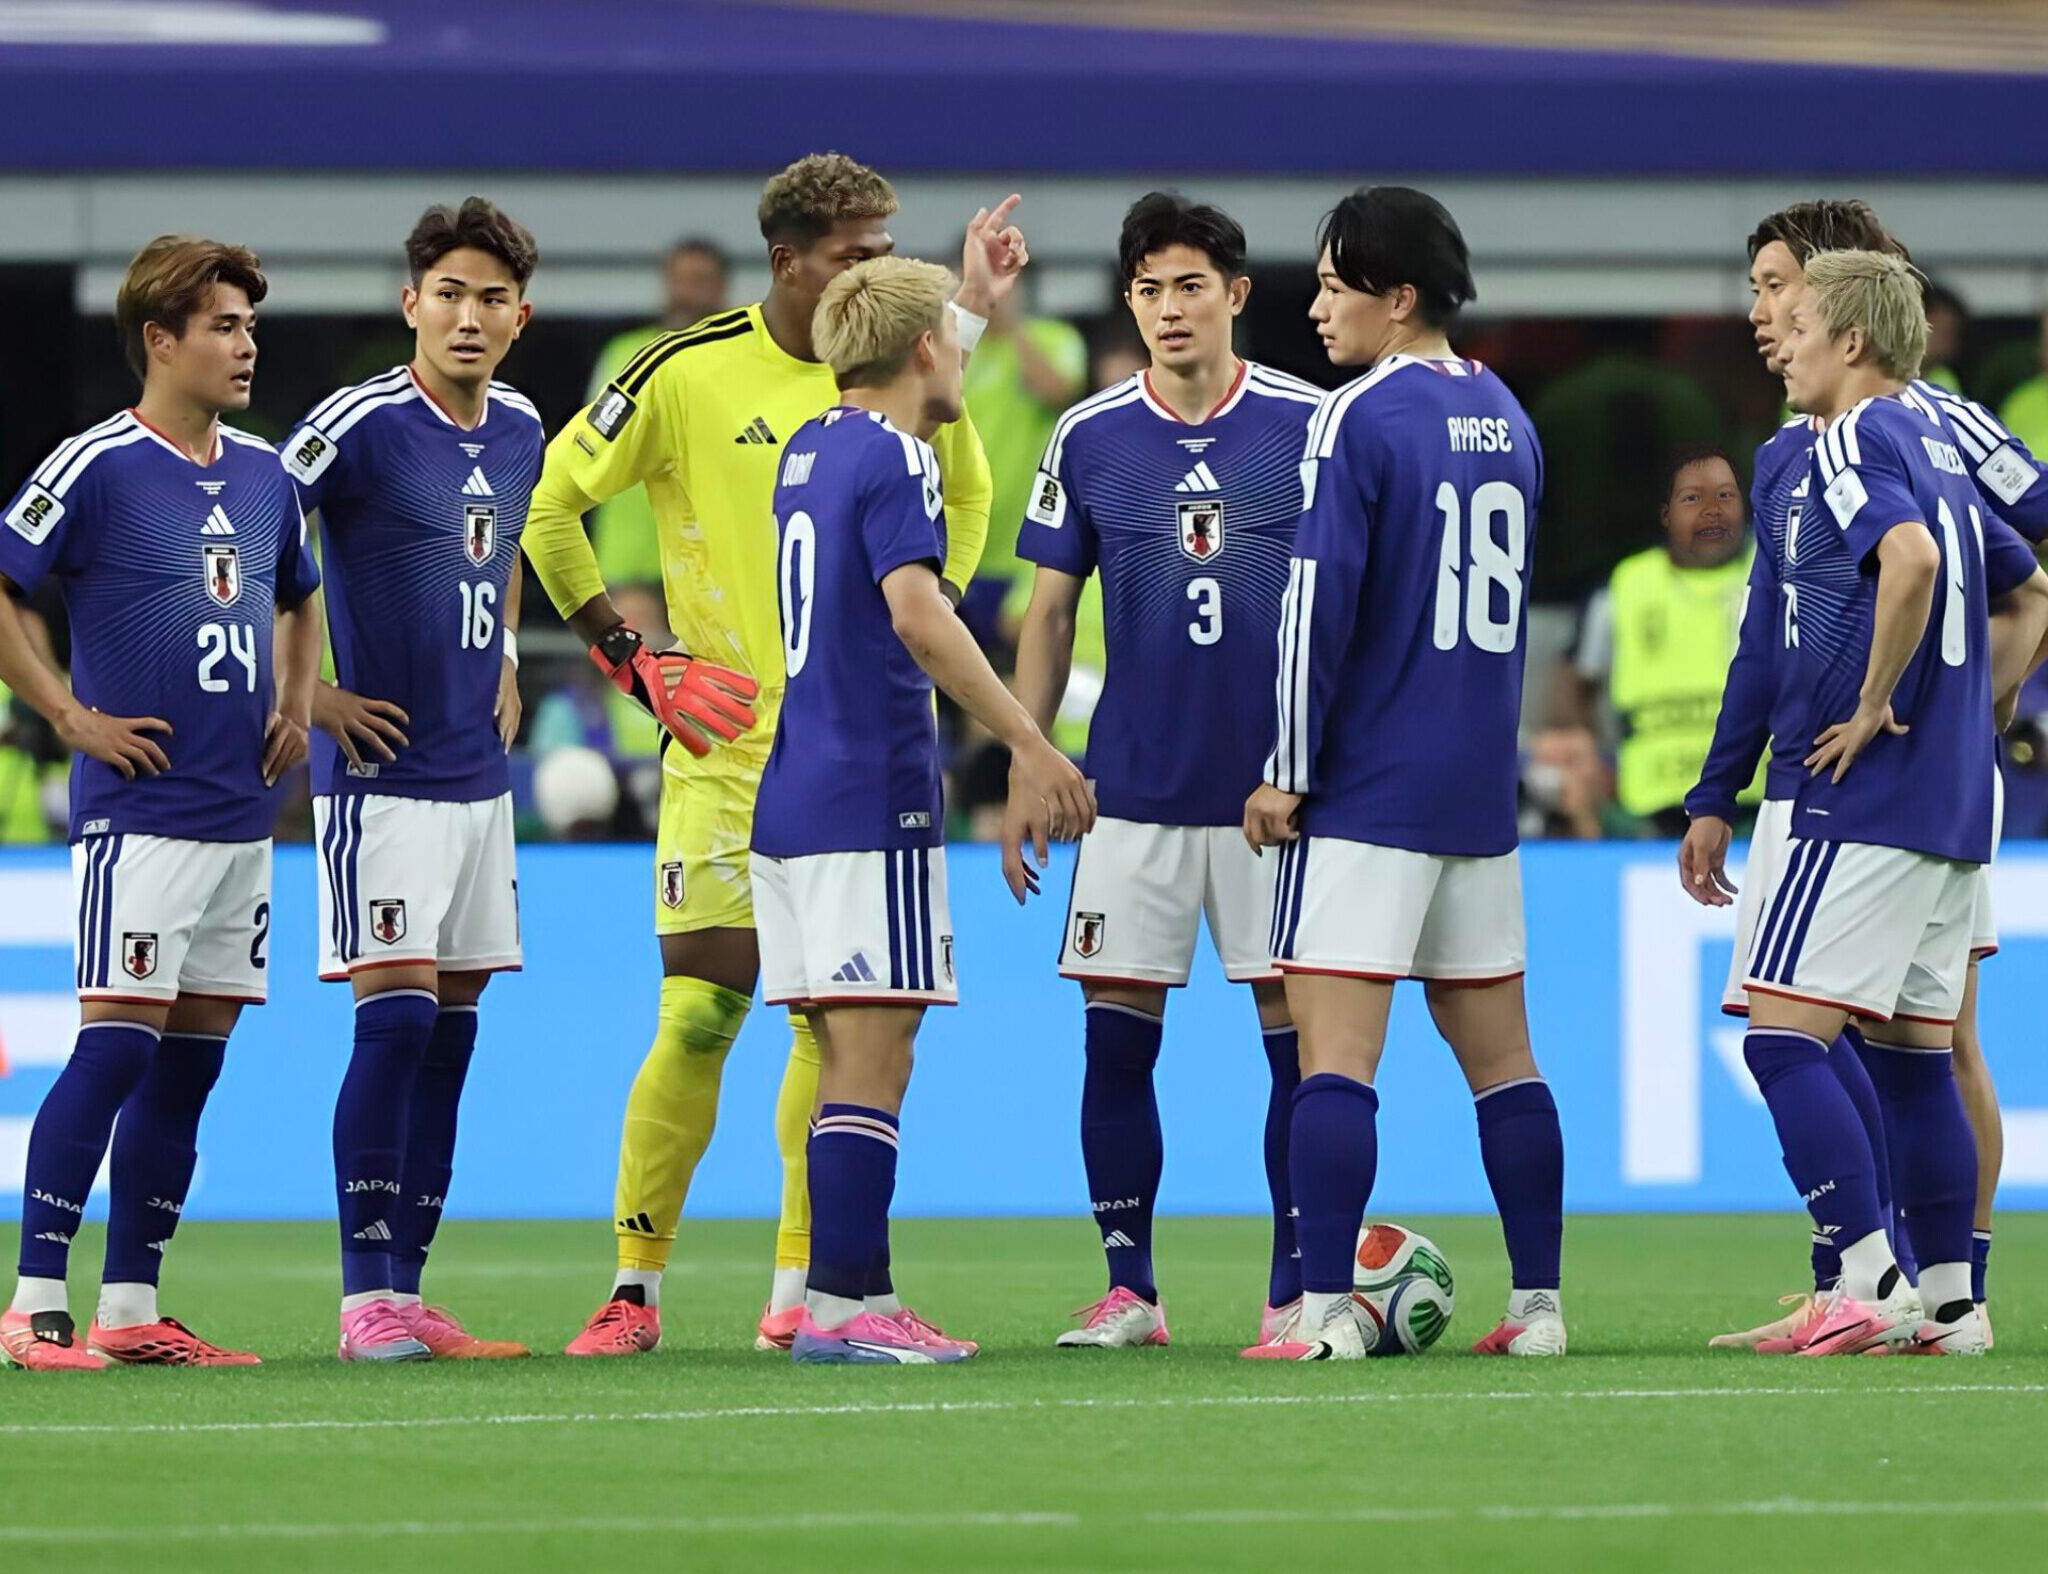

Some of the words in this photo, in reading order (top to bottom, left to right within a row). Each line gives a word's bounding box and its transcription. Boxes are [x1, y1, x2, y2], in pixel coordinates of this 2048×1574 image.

[1448, 416, 1513, 452] AYASE
[1433, 481, 1526, 654] 18
[459, 580, 496, 650] 16
[1186, 577, 1223, 646] 3
[196, 623, 257, 694] 24
